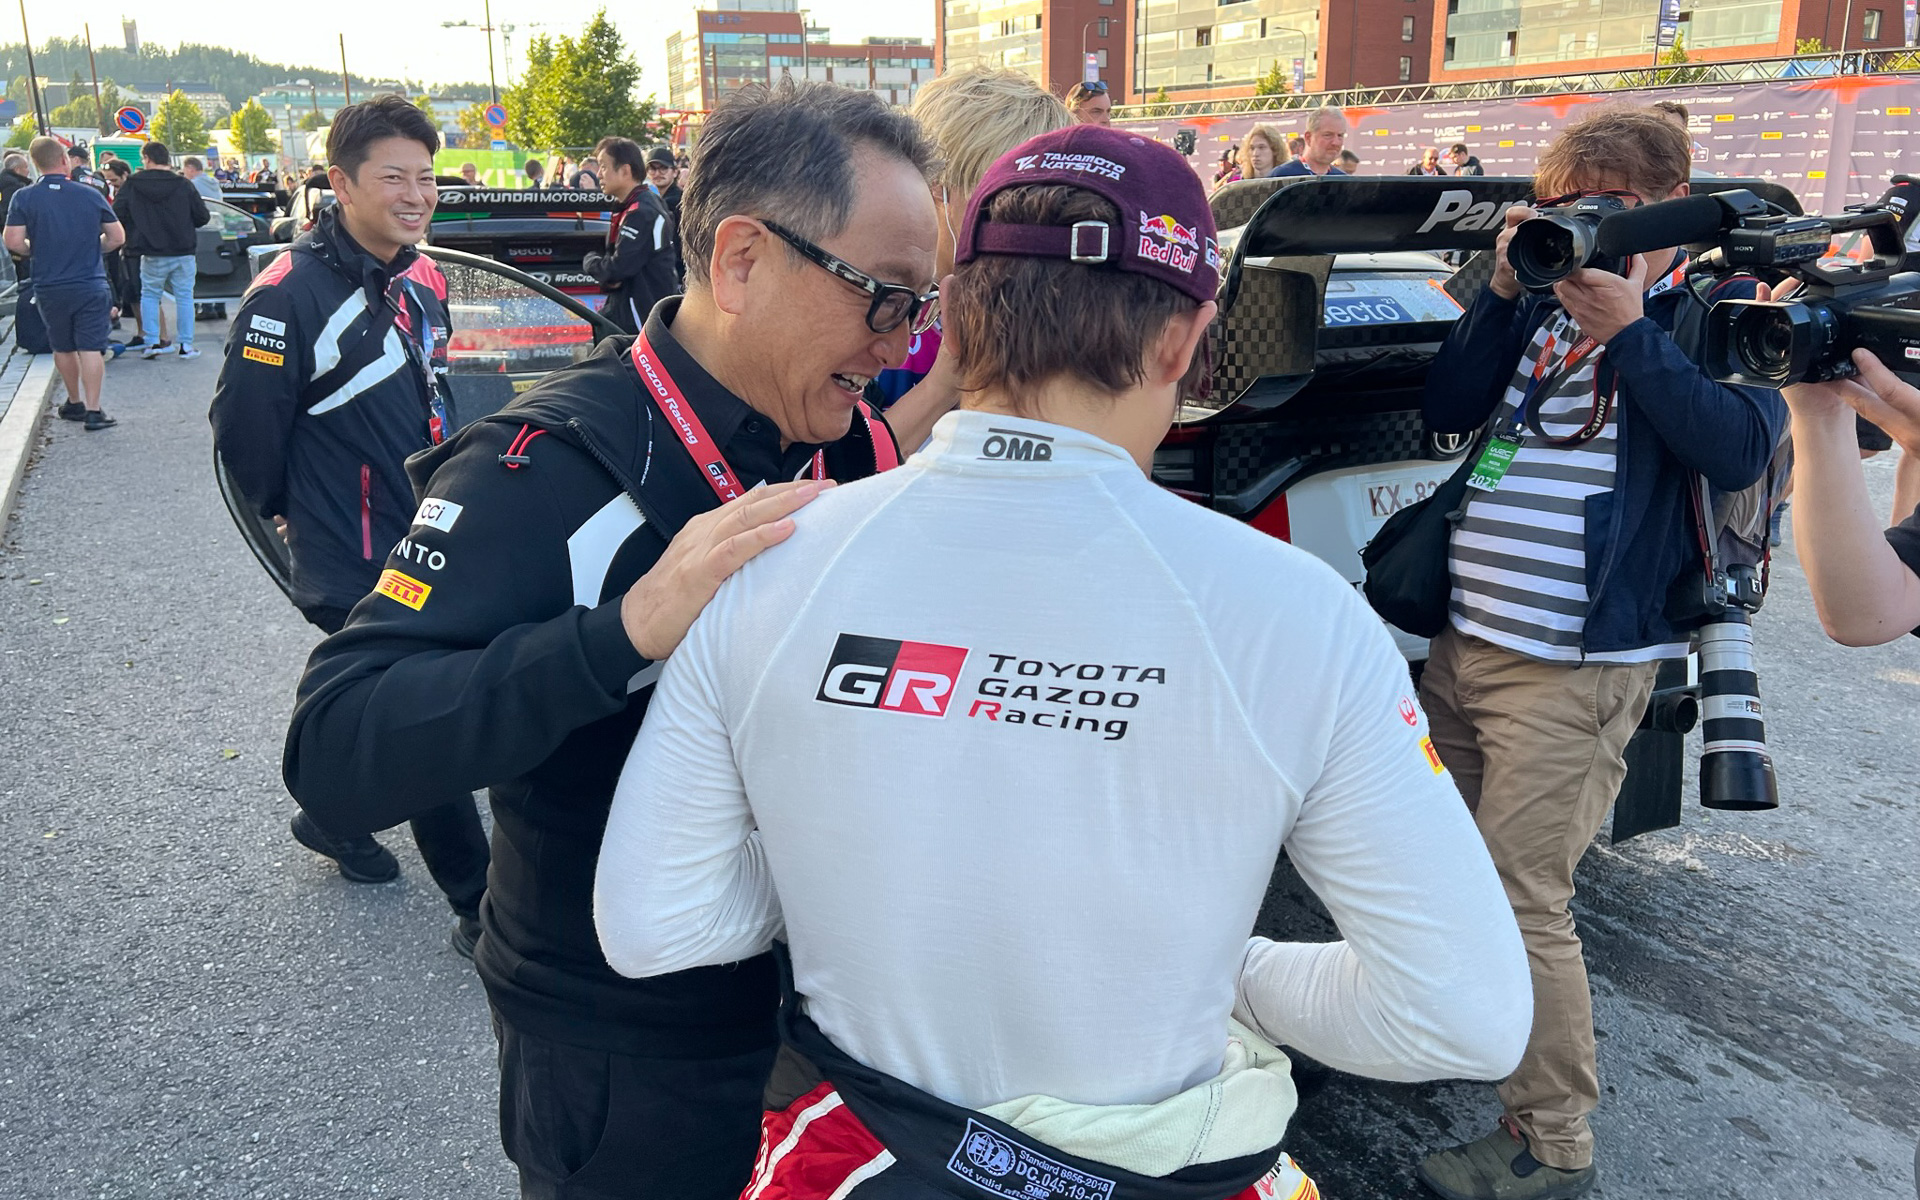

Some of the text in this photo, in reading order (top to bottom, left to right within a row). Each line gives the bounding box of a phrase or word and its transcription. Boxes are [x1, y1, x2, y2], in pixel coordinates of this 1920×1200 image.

[1040, 160, 1120, 181] KATSUTA
[1041, 152, 1126, 174] TAKAMOTO
[469, 192, 619, 203] HYUNDAI MOTORSPO
[1140, 236, 1198, 273] Red Bull
[638, 353, 699, 445] GAZOO Racing
[1580, 396, 1608, 439] Canon
[707, 462, 729, 488] GR
[988, 654, 1166, 685] TOYOTA
[823, 663, 952, 713] GR
[978, 678, 1140, 709] GAZOO
[968, 699, 1129, 740] Racing
[953, 1159, 974, 1177] Not
[975, 1173, 1002, 1191] valid
[1019, 1150, 1109, 1193] Standard 8856-2018
